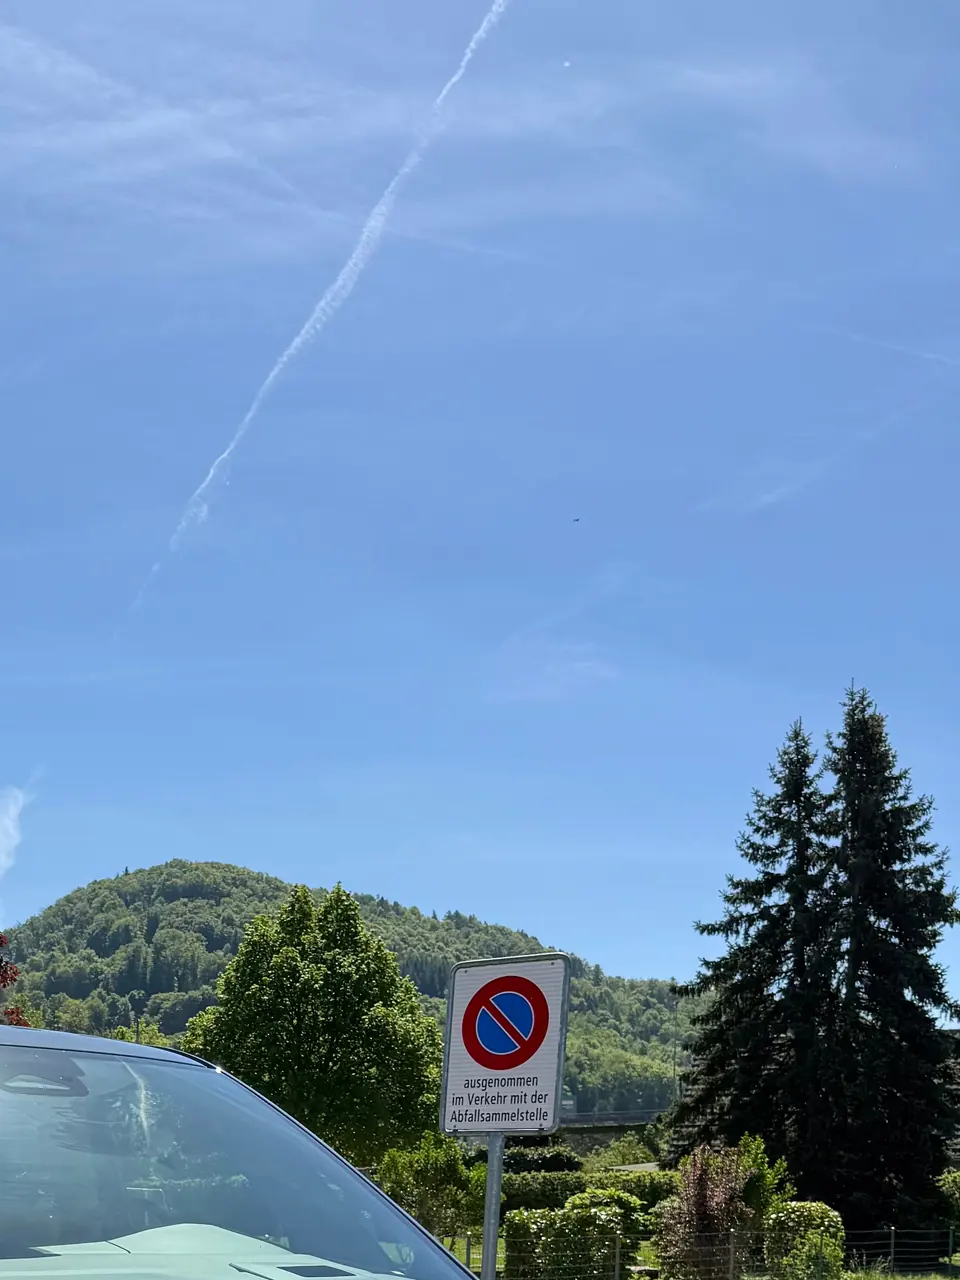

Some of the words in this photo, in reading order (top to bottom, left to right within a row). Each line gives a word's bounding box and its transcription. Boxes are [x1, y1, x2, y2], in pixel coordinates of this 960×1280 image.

[463, 1076, 538, 1091] ausgenommen
[451, 1093, 464, 1106] im
[468, 1092, 507, 1106] Verkehr
[510, 1091, 528, 1104] mit
[530, 1090, 548, 1104] der
[450, 1107, 548, 1123] Abfallsammelstelle
